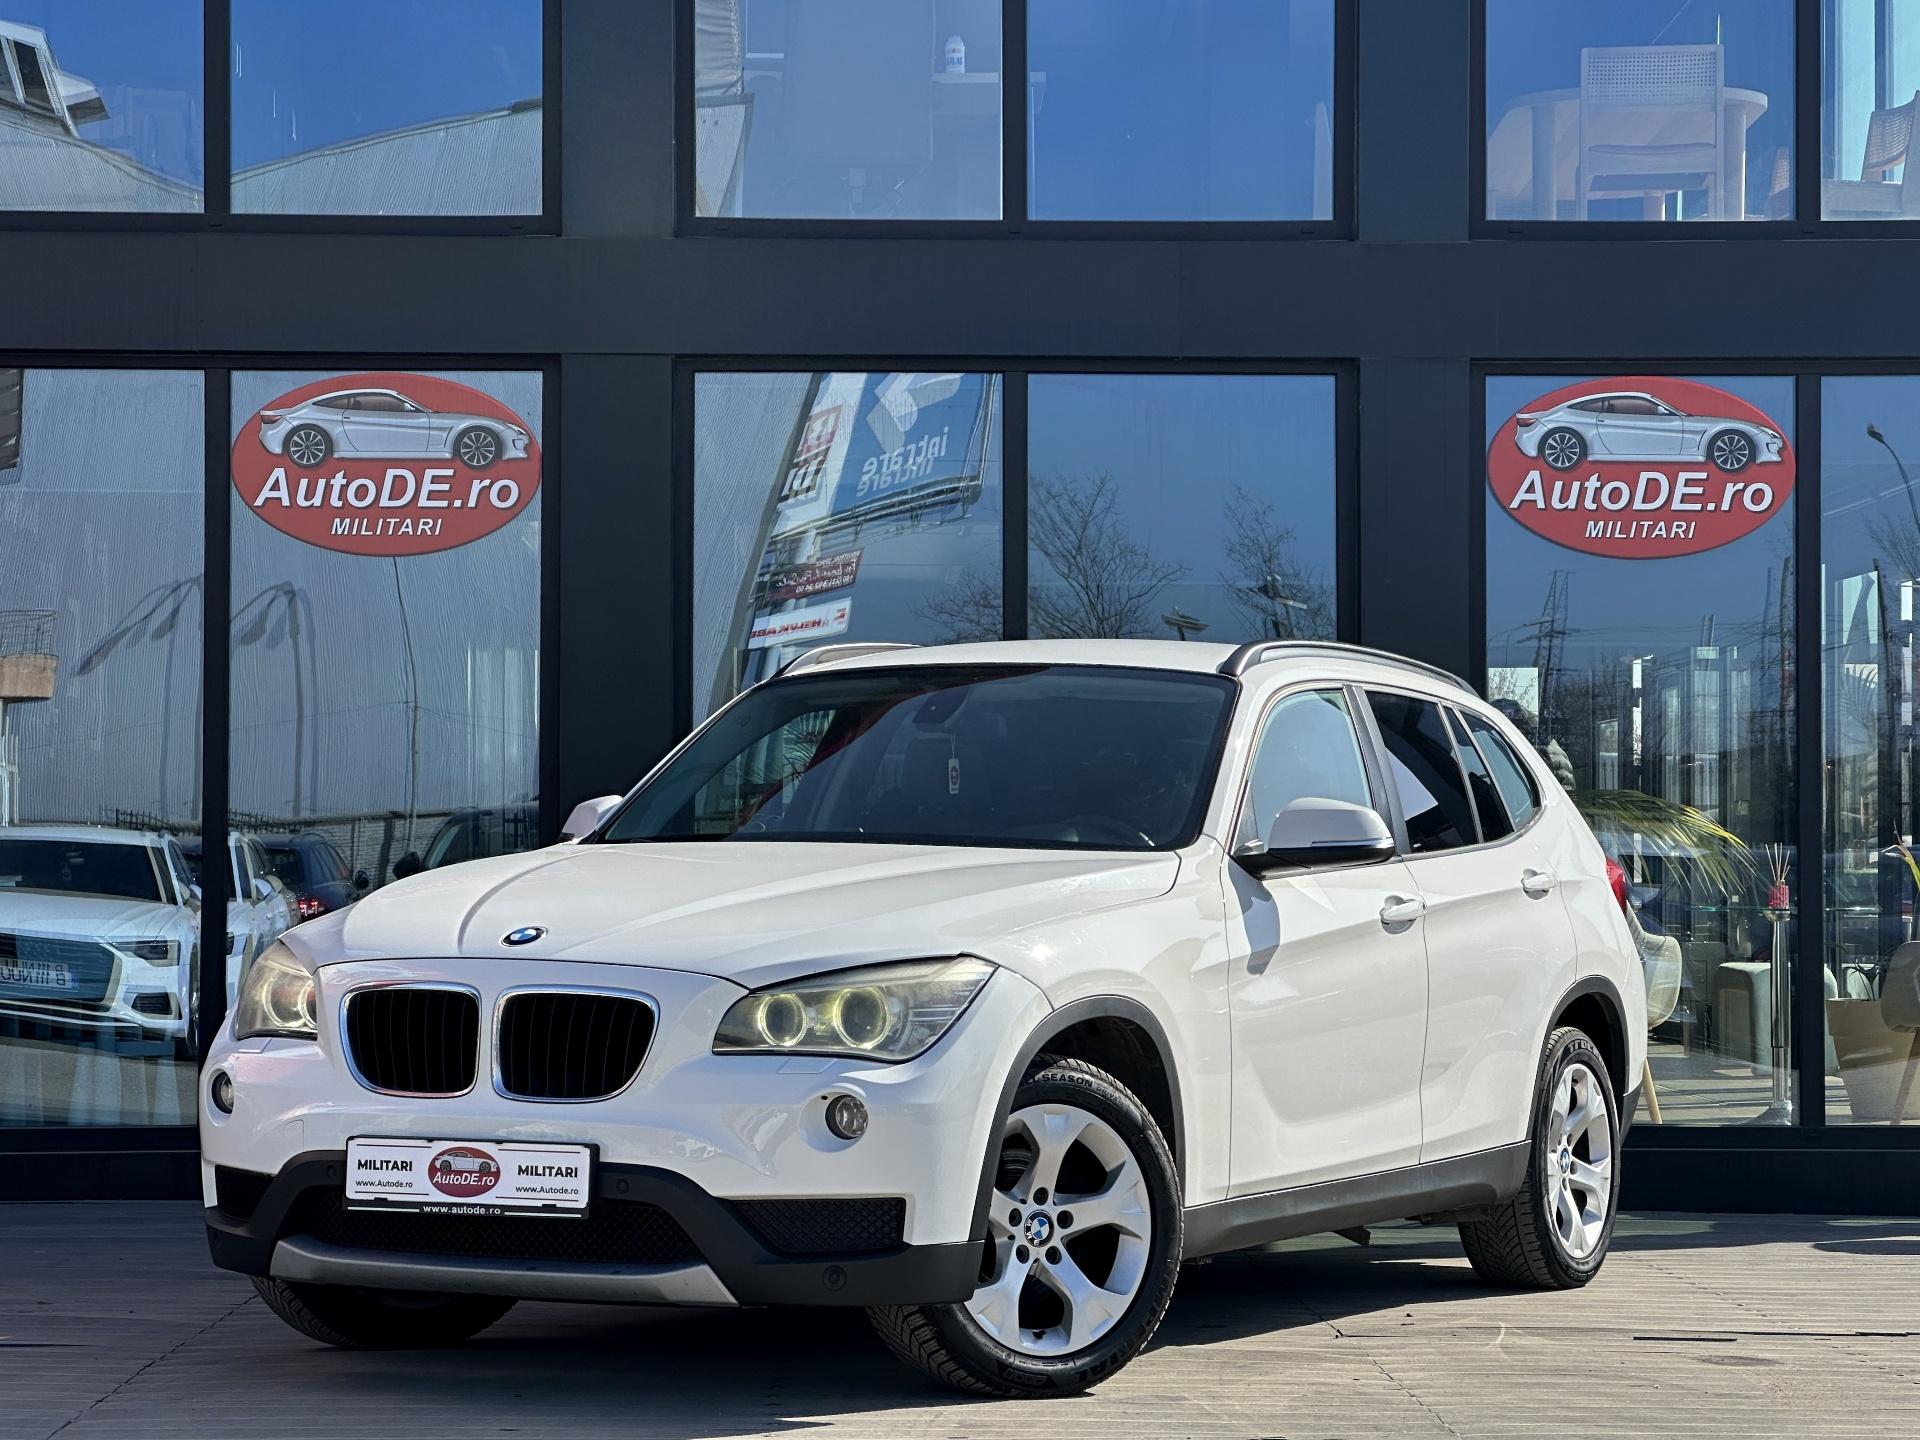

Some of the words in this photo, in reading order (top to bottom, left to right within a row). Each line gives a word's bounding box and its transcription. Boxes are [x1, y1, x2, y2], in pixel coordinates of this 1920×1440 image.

[254, 467, 520, 510] AutoDE.ro
[1509, 470, 1774, 512] AutoDE.ro
[330, 518, 442, 537] MILITARI
[1585, 520, 1696, 539] MILITARI
[1042, 1073, 1093, 1089] SEASON
[357, 1159, 413, 1172] MILITARI
[517, 1164, 578, 1178] MILITARI
[355, 1178, 413, 1188] www.Autode.ro
[432, 1171, 495, 1187] AutoDE.ro
[516, 1185, 579, 1195] www.Autode.ro
[422, 1205, 501, 1215] www.autode.ro
